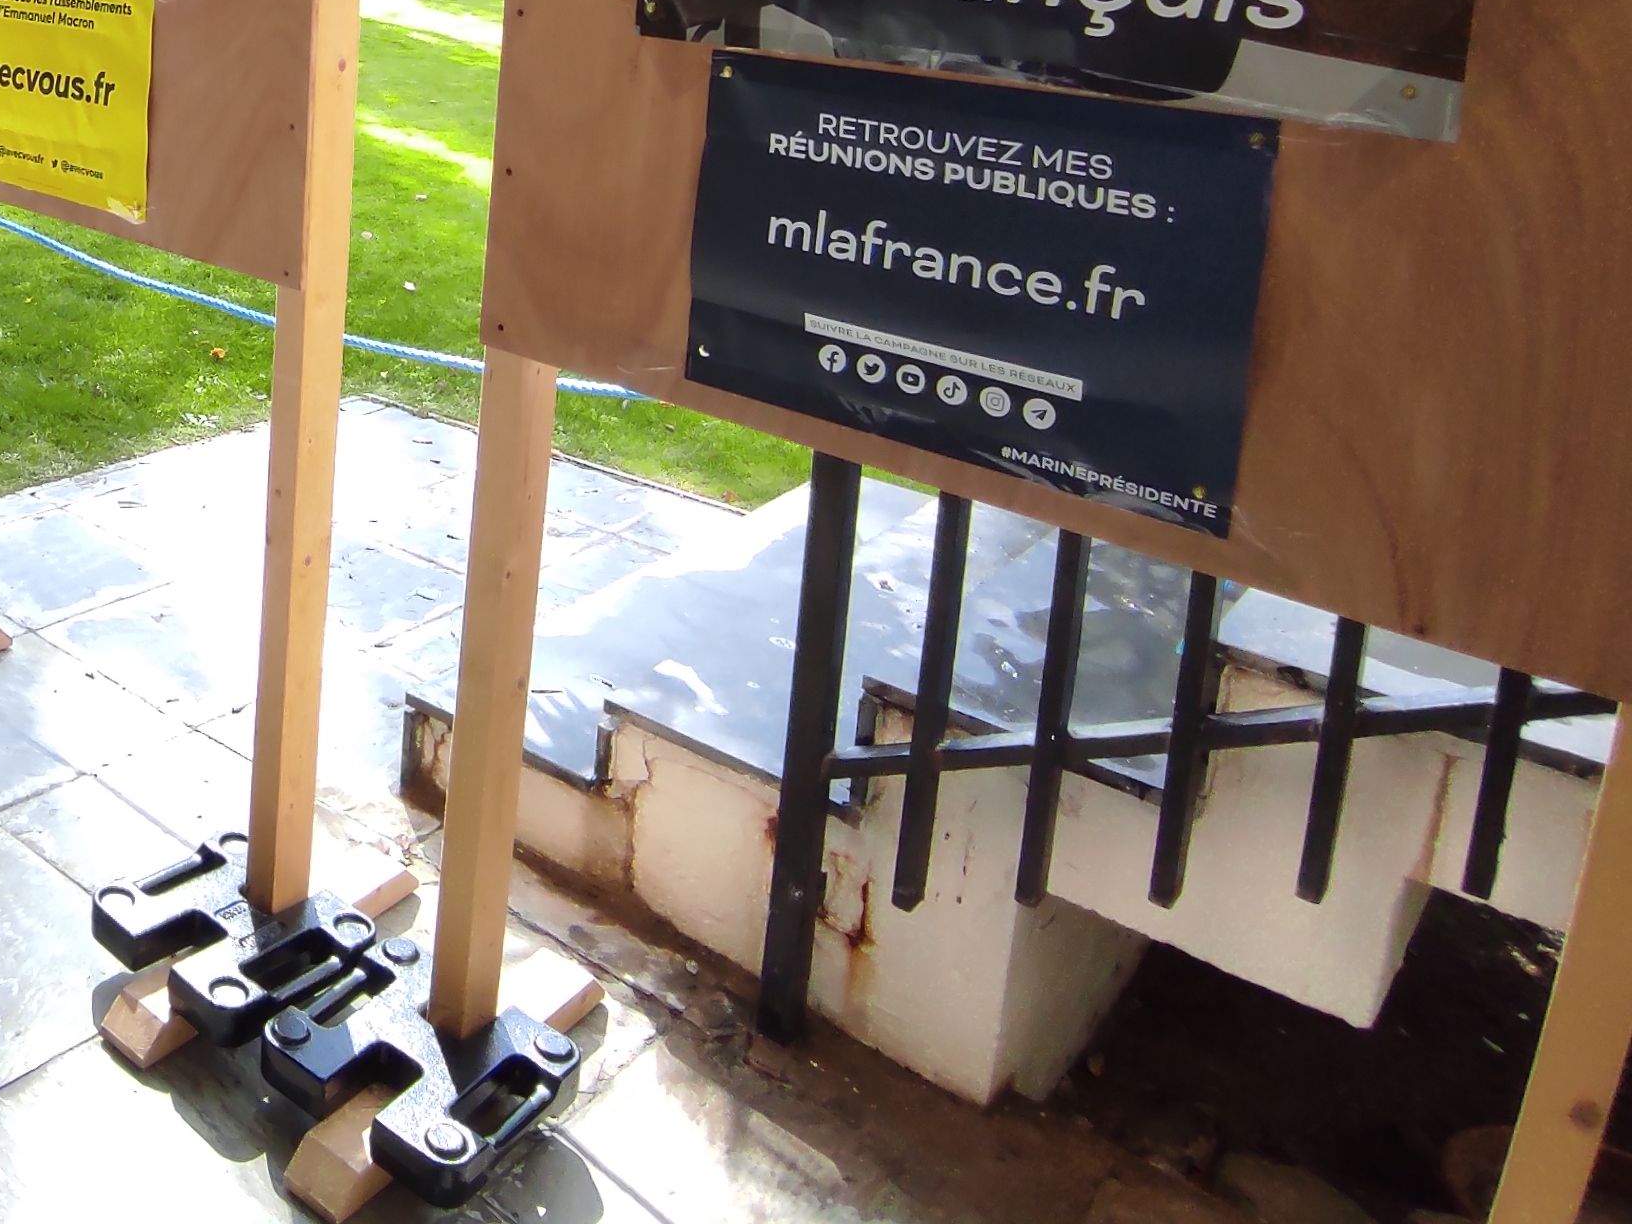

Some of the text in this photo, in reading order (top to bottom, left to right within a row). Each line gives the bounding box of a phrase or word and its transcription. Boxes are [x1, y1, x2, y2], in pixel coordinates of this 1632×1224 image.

[57, 12, 95, 29] Macron
[769, 130, 935, 181] RÉUNIONS
[944, 162, 1157, 219] PUBLIQUES
[818, 112, 1113, 180] RETROUVEZ MES
[768, 209, 1146, 320] mlafrance.fr
[809, 320, 1076, 393] SUIVRE LA CAMPAGNE SUR LES RÉSEAUX
[1000, 445, 1218, 519] #MARINEPRÉSIDENTE
